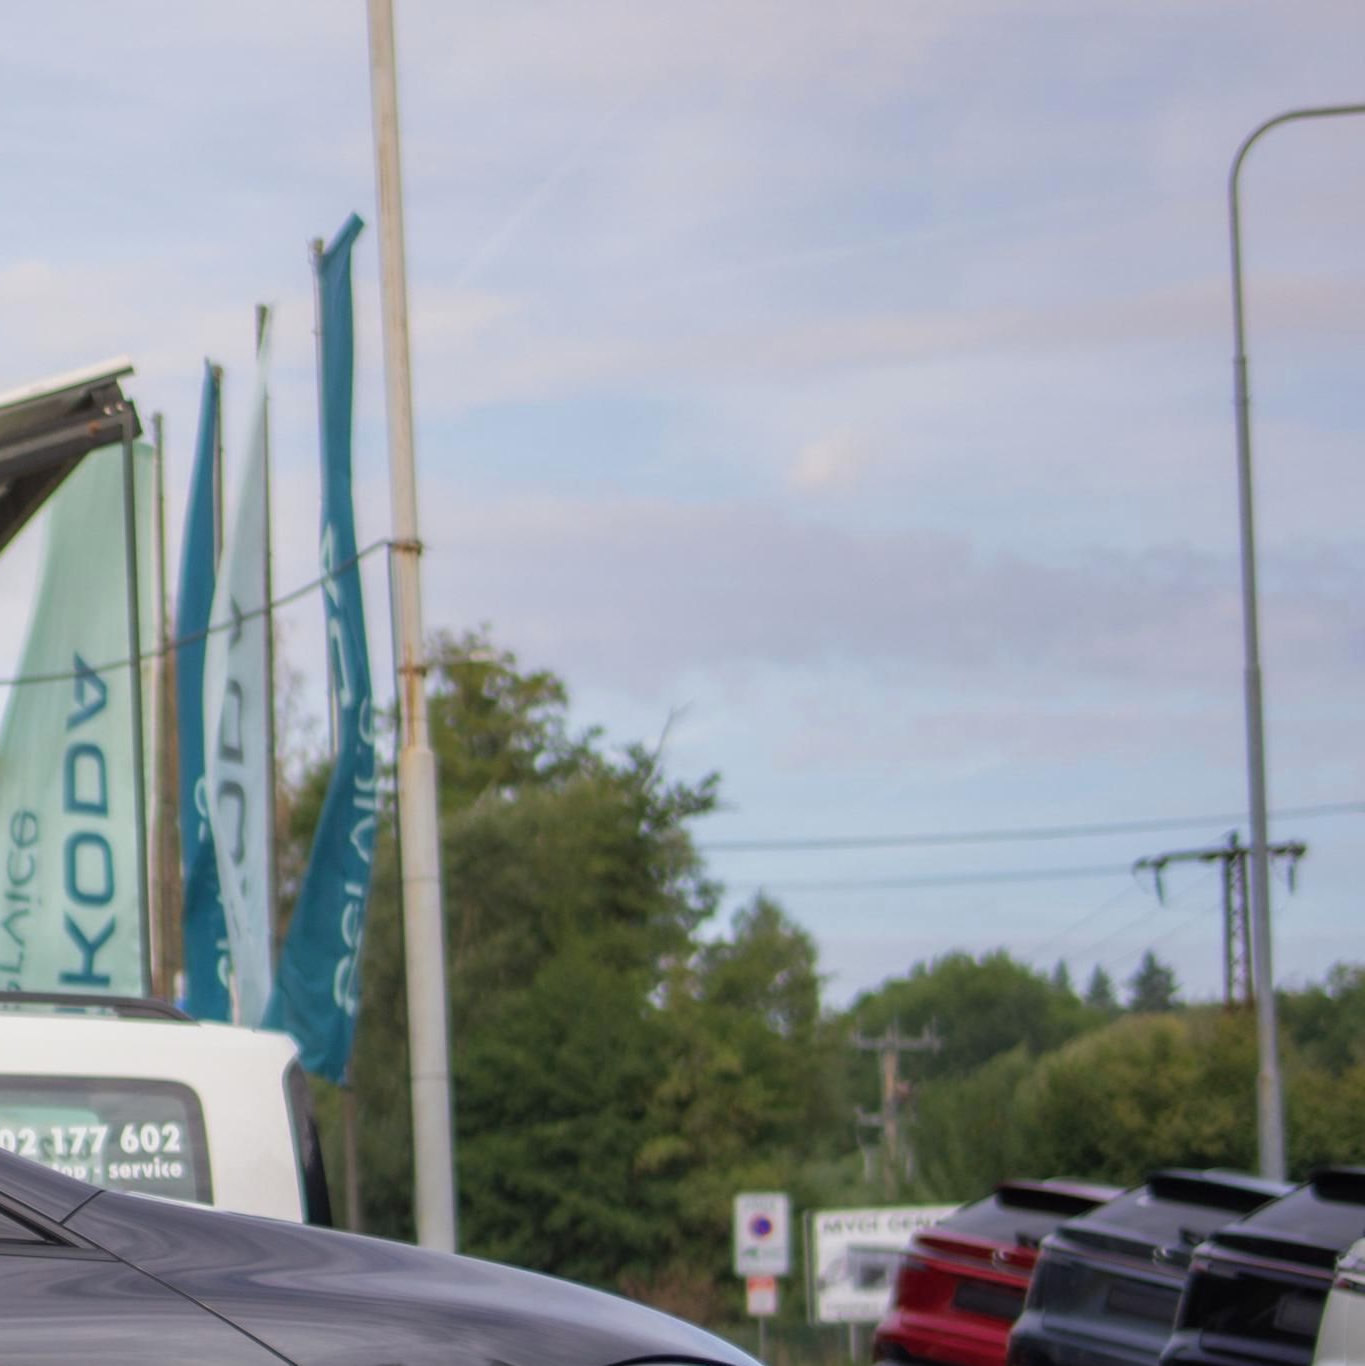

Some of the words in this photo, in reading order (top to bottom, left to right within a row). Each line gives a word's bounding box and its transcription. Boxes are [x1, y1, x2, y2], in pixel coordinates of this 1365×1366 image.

[51, 1125, 108, 1154] 177
[121, 1123, 181, 1153] 602
[108, 1157, 183, 1179] service
